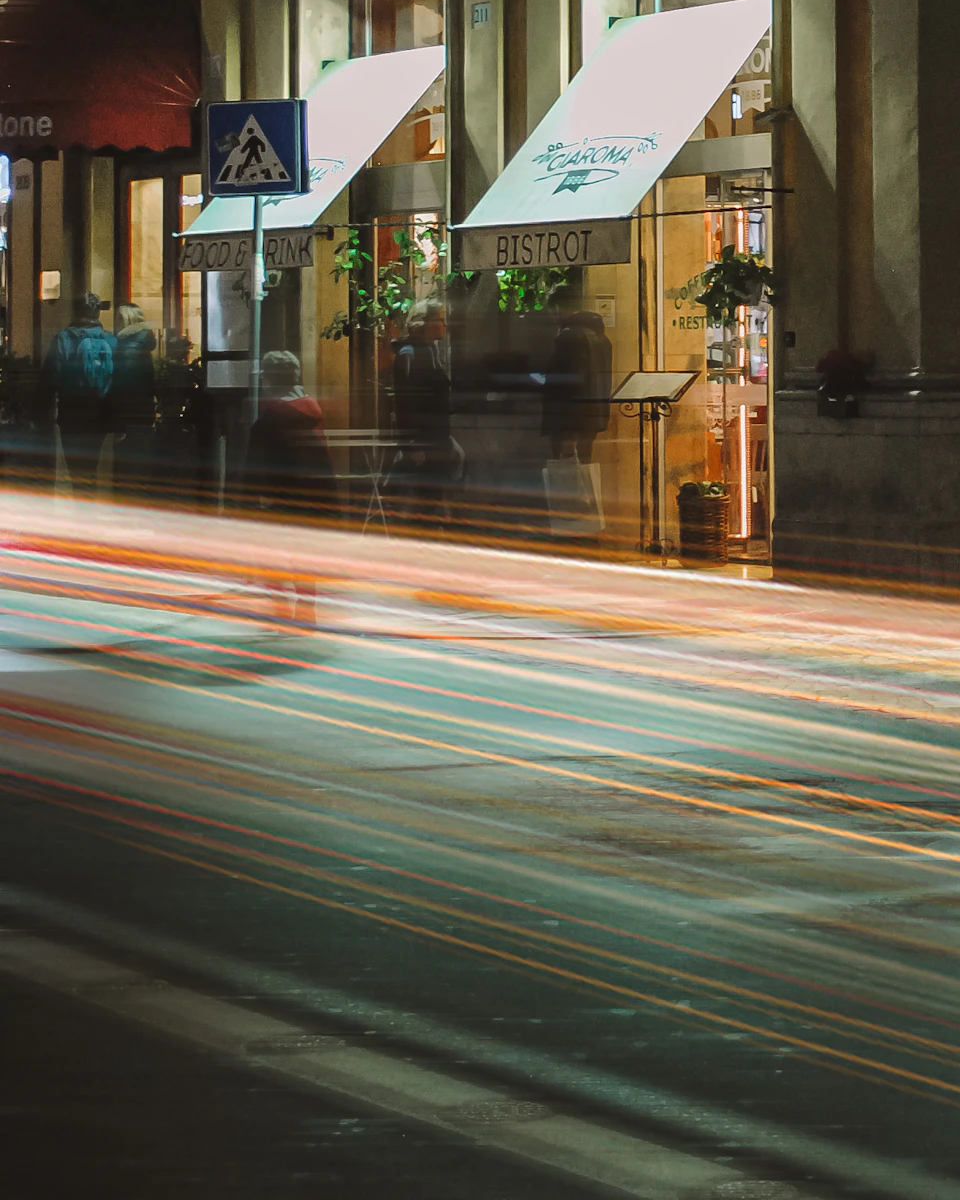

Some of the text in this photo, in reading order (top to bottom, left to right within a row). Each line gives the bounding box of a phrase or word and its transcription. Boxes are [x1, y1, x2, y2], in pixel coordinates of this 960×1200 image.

[474, 8, 488, 23] 211
[181, 234, 314, 270] FOOD & RINK
[496, 230, 593, 266] BISTROT
